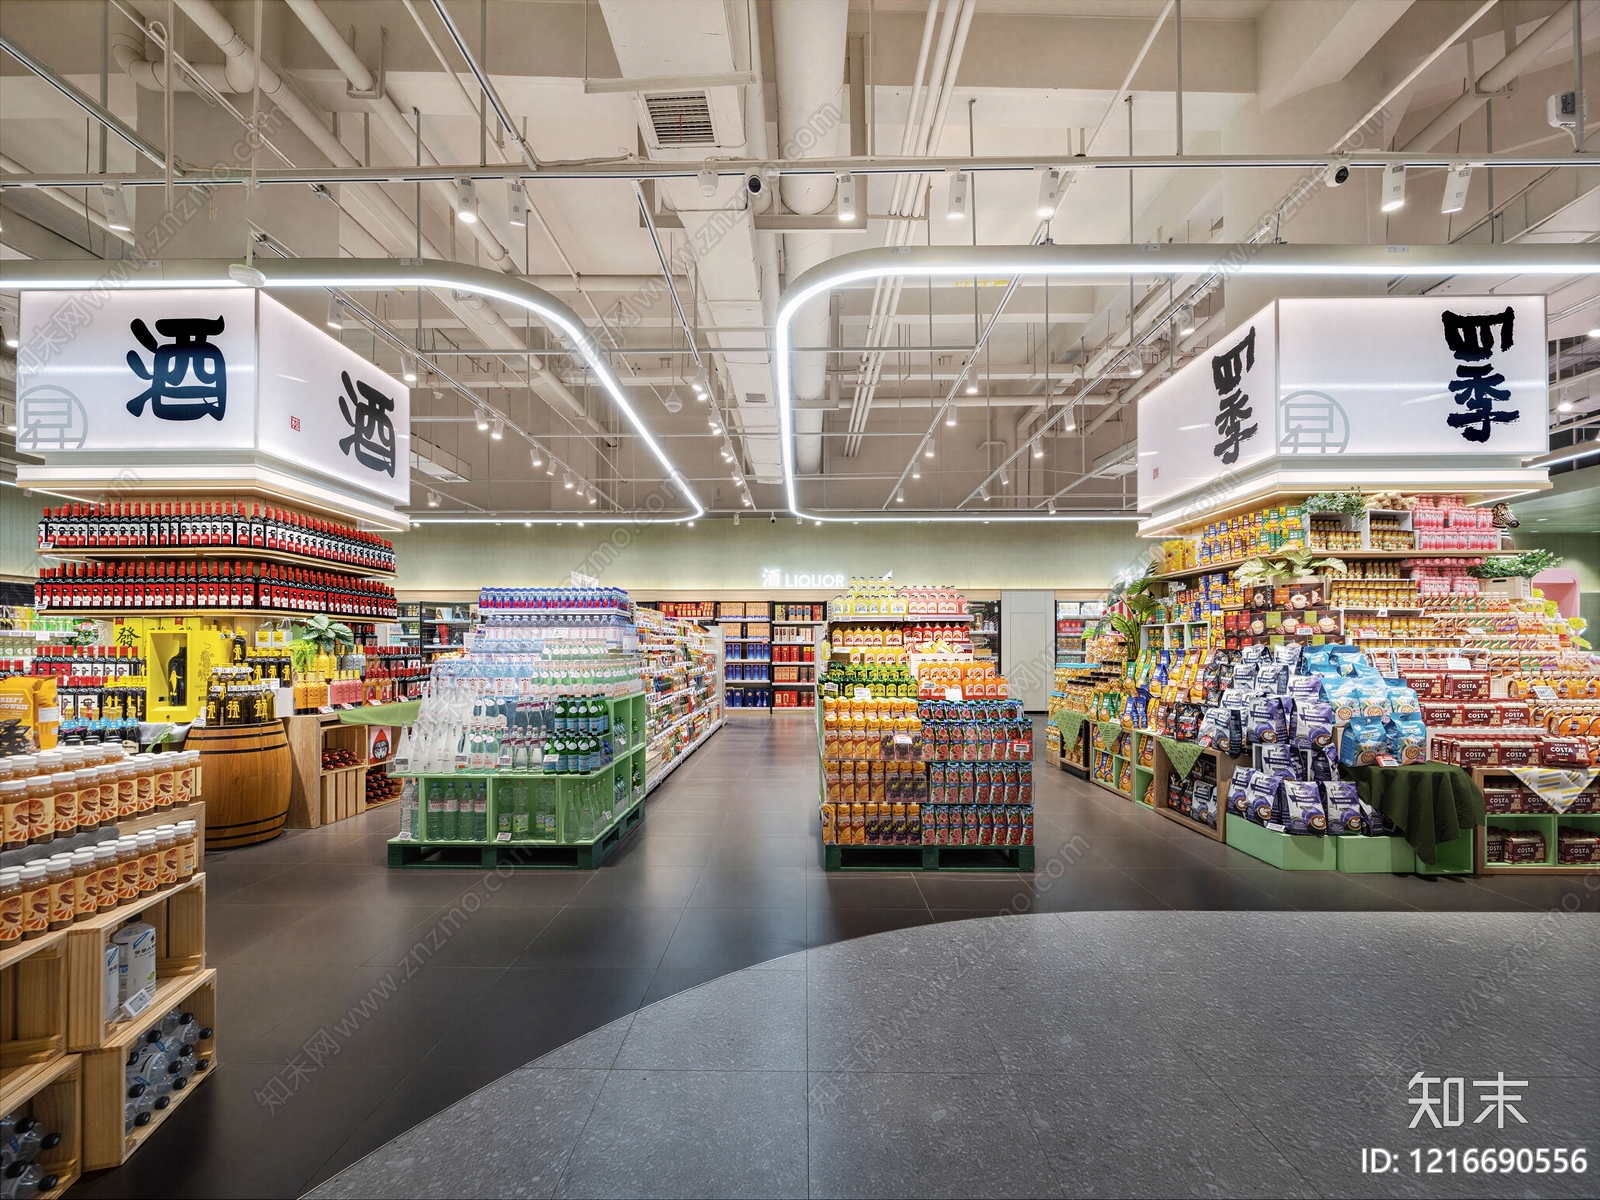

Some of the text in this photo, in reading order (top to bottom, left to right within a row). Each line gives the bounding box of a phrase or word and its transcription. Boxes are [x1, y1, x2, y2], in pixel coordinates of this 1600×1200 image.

[125, 314, 226, 422] 酒
[1211, 326, 1258, 465] 四季
[1441, 306, 1520, 443] 四季
[338, 370, 396, 479] 酒
[762, 568, 845, 587] 酒 LIQUOR
[115, 627, 141, 648] 發
